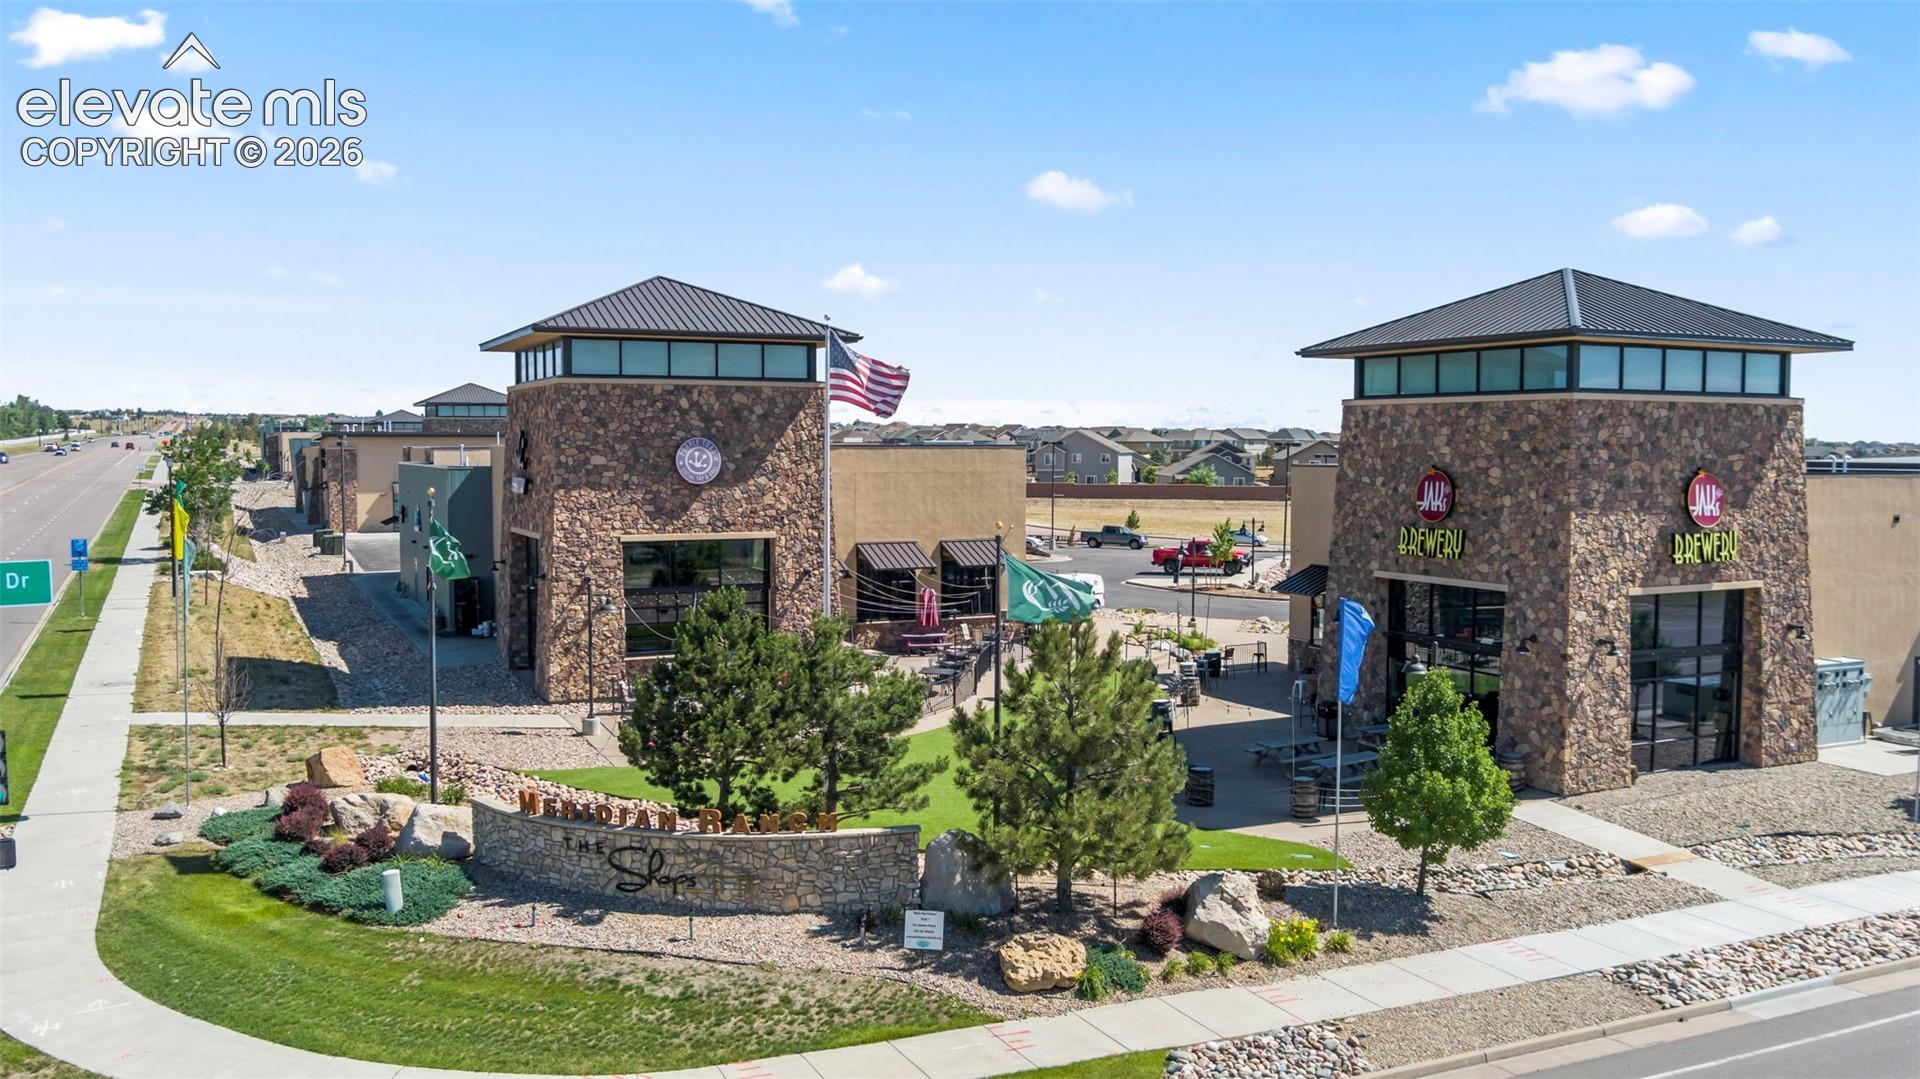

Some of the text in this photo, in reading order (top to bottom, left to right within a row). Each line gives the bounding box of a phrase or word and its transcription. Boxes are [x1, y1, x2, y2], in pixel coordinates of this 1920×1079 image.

[1397, 526, 1463, 559] BREWERY
[1672, 530, 1738, 565] BREWERY
[6, 572, 29, 589] Dr
[519, 789, 838, 834] MERIDIAN RANCH
[563, 836, 607, 852] THE
[608, 847, 697, 894] Shops
